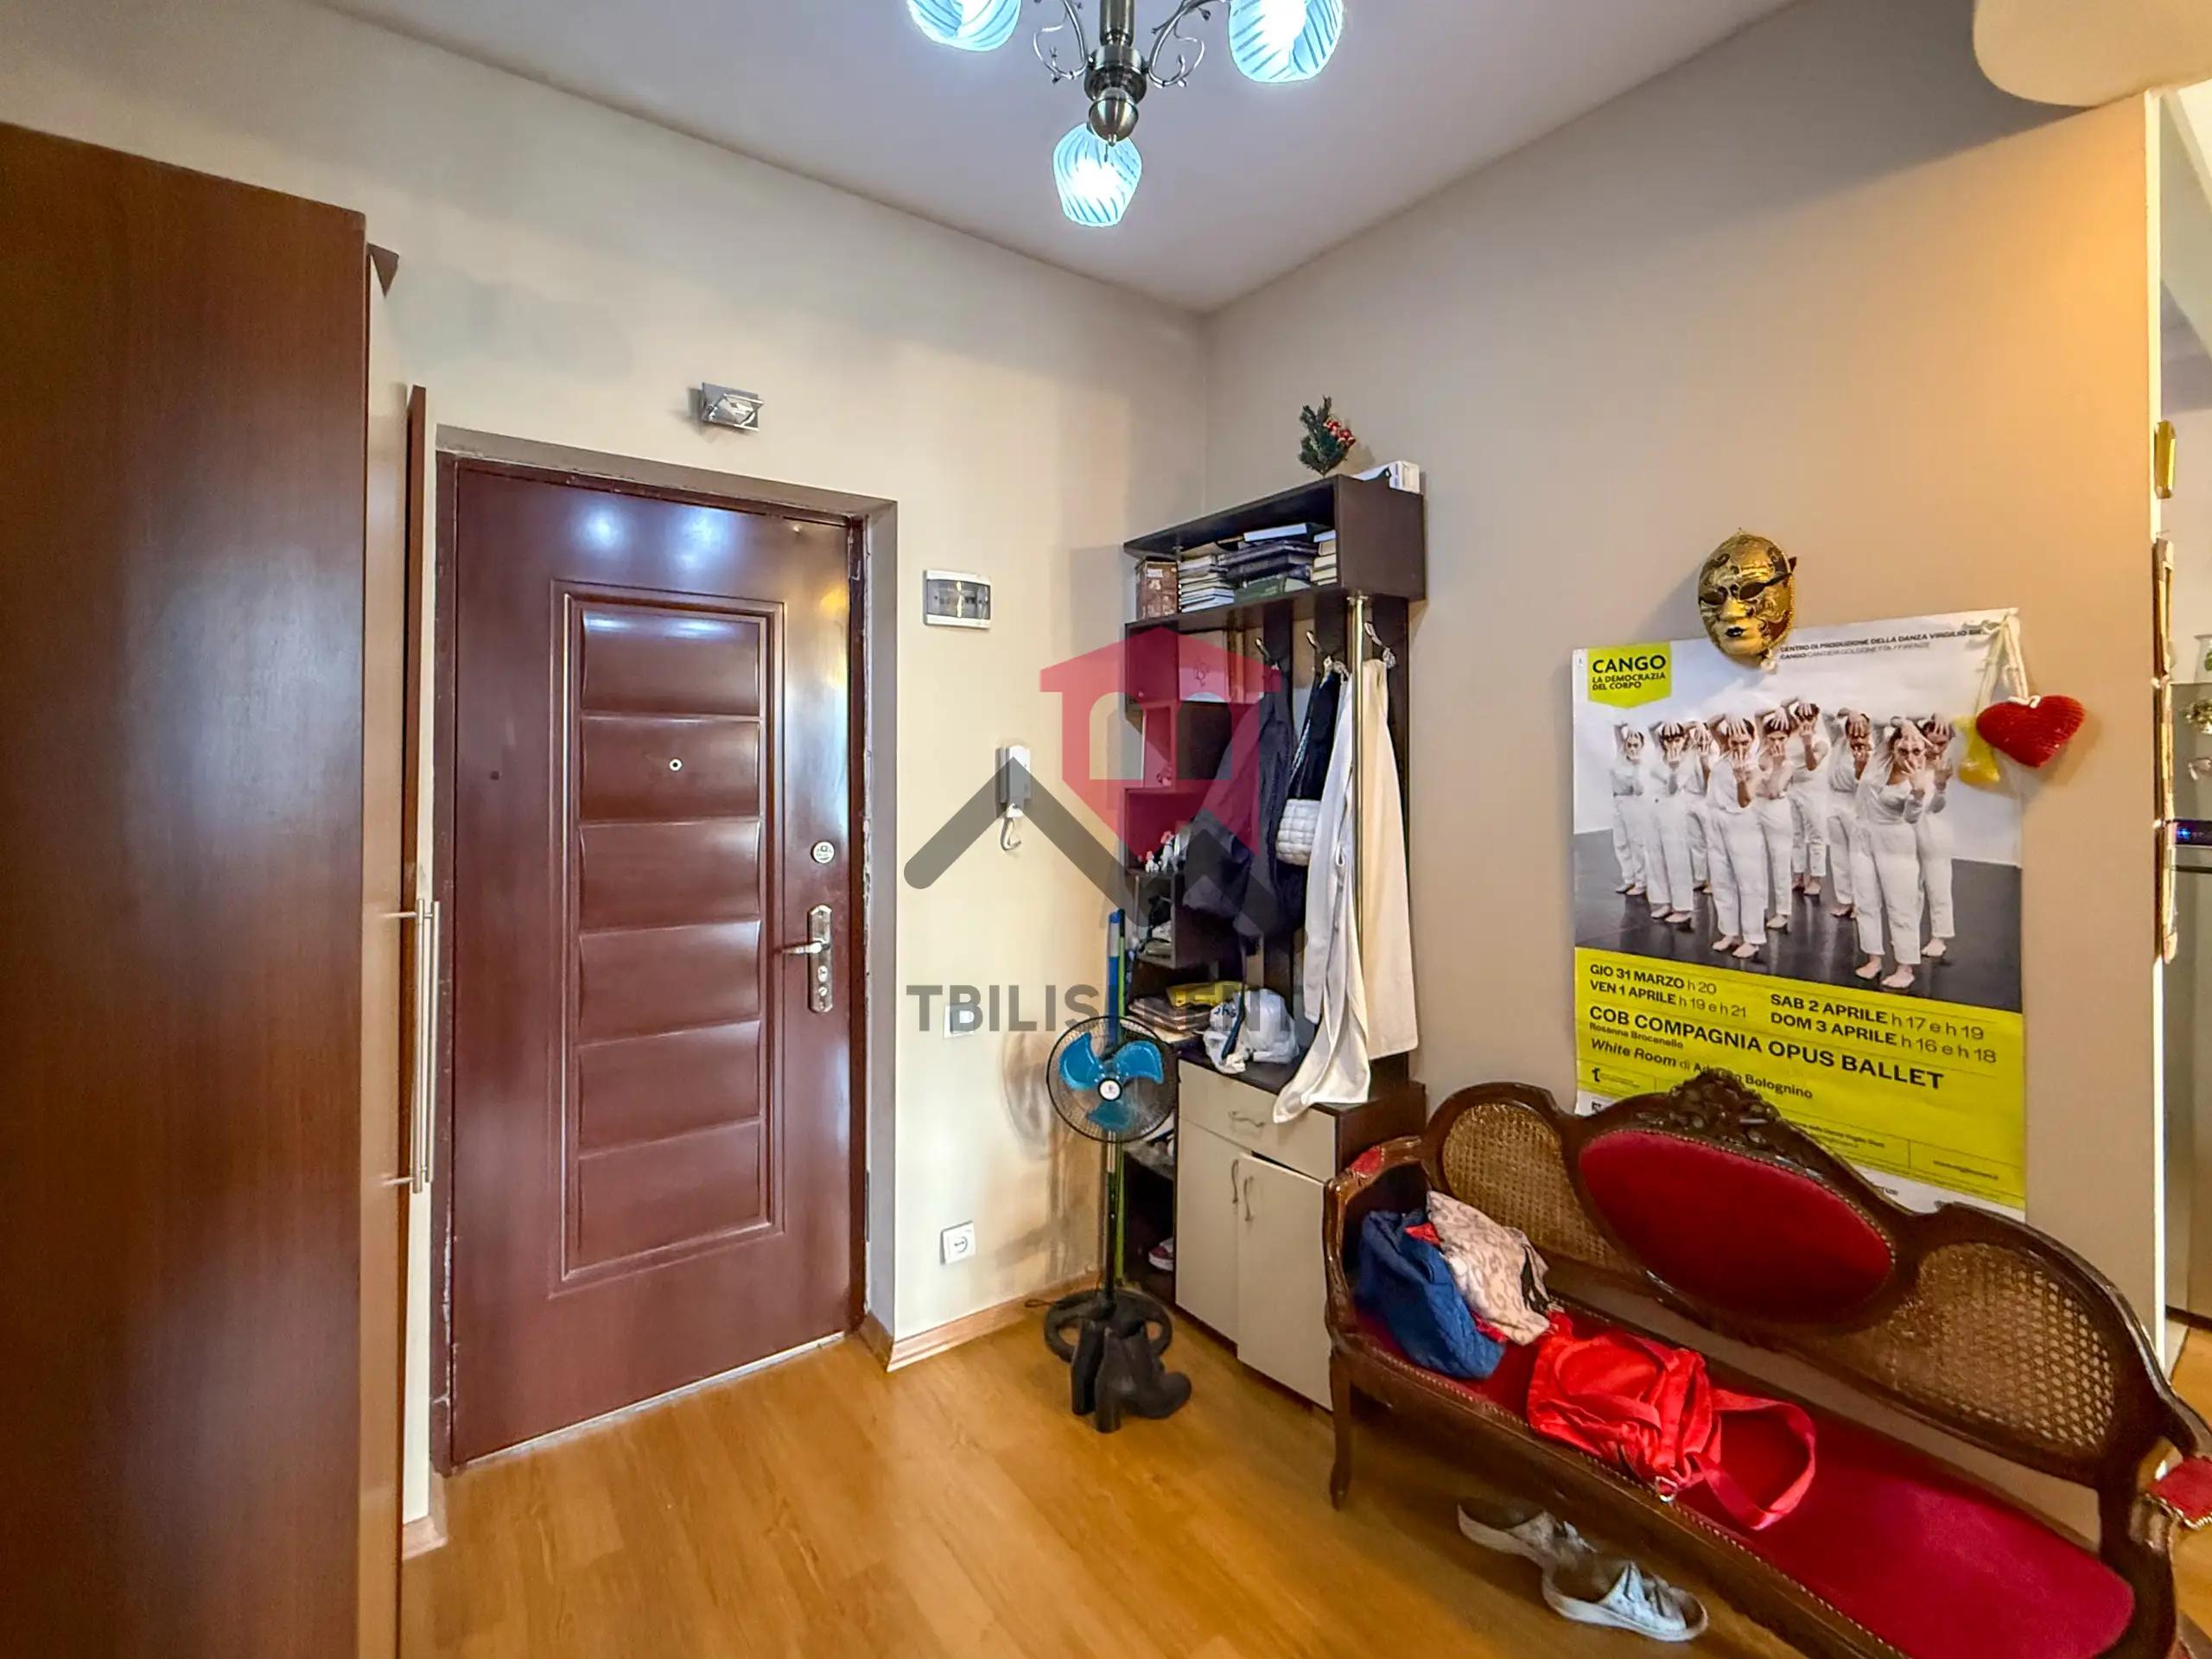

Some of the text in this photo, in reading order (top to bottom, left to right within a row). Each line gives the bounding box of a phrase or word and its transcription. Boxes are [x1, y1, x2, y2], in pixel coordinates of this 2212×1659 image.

[1898, 634, 1928, 643] DANZA
[1592, 654, 1666, 673] CANGO
[1605, 672, 1666, 683] DEMOCRAZIA
[1590, 964, 1717, 995] GIO 31 MARZO h 20
[1590, 980, 1617, 994] VEN
[1618, 985, 1625, 995] 1
[1629, 987, 1675, 1005] APRILE
[1679, 995, 1687, 1007] h
[1690, 997, 1706, 1010] 19
[1719, 1002, 1728, 1014] h
[1731, 1005, 1746, 1018] 21
[1590, 1022, 1629, 1038] Rosanna
[1771, 994, 1984, 1040] SAB 2 APRILE h 17 e h 19
[1590, 1006, 1944, 1090] COB COMPAGNIA OPUS BALLET
[1771, 1012, 1997, 1064] DOM 3 APRILE h 16 e h 18
[1591, 1038, 1630, 1057] White
[1634, 1047, 1676, 1067] Room
[1745, 1073, 1813, 1100] Bolognino
